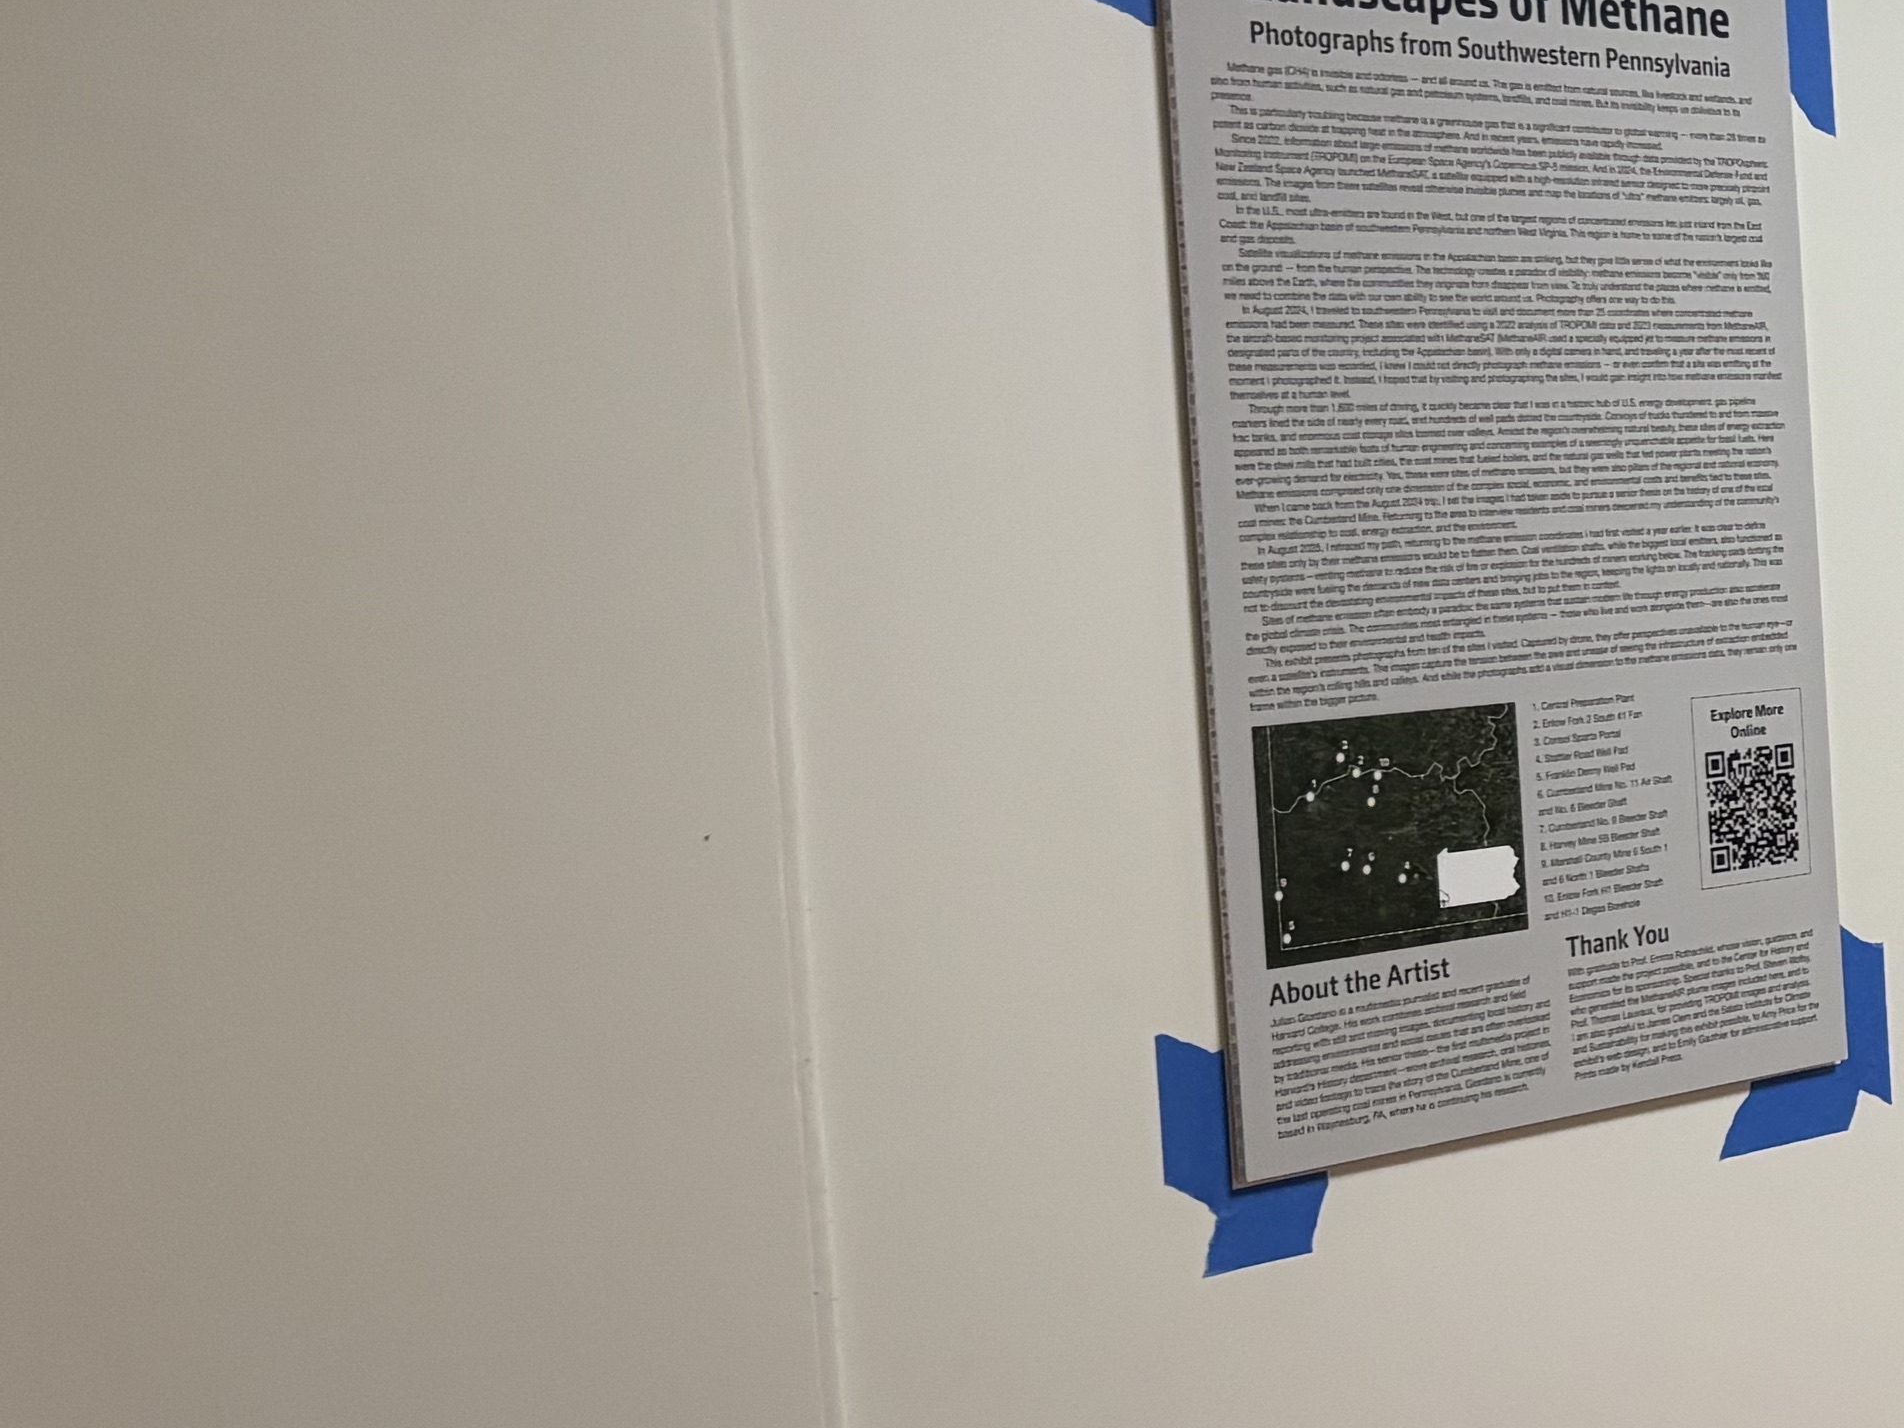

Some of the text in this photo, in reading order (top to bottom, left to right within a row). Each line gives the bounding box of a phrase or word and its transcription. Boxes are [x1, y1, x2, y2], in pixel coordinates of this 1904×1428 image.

[1250, 20, 1730, 77] Photographs from Southwestern Pennsylvania
[1710, 704, 1783, 723] Explore More
[1730, 724, 1766, 738] Online
[1565, 928, 1628, 957] Thank
[1633, 925, 1669, 946] You
[1269, 958, 1449, 1006] About the Artist
